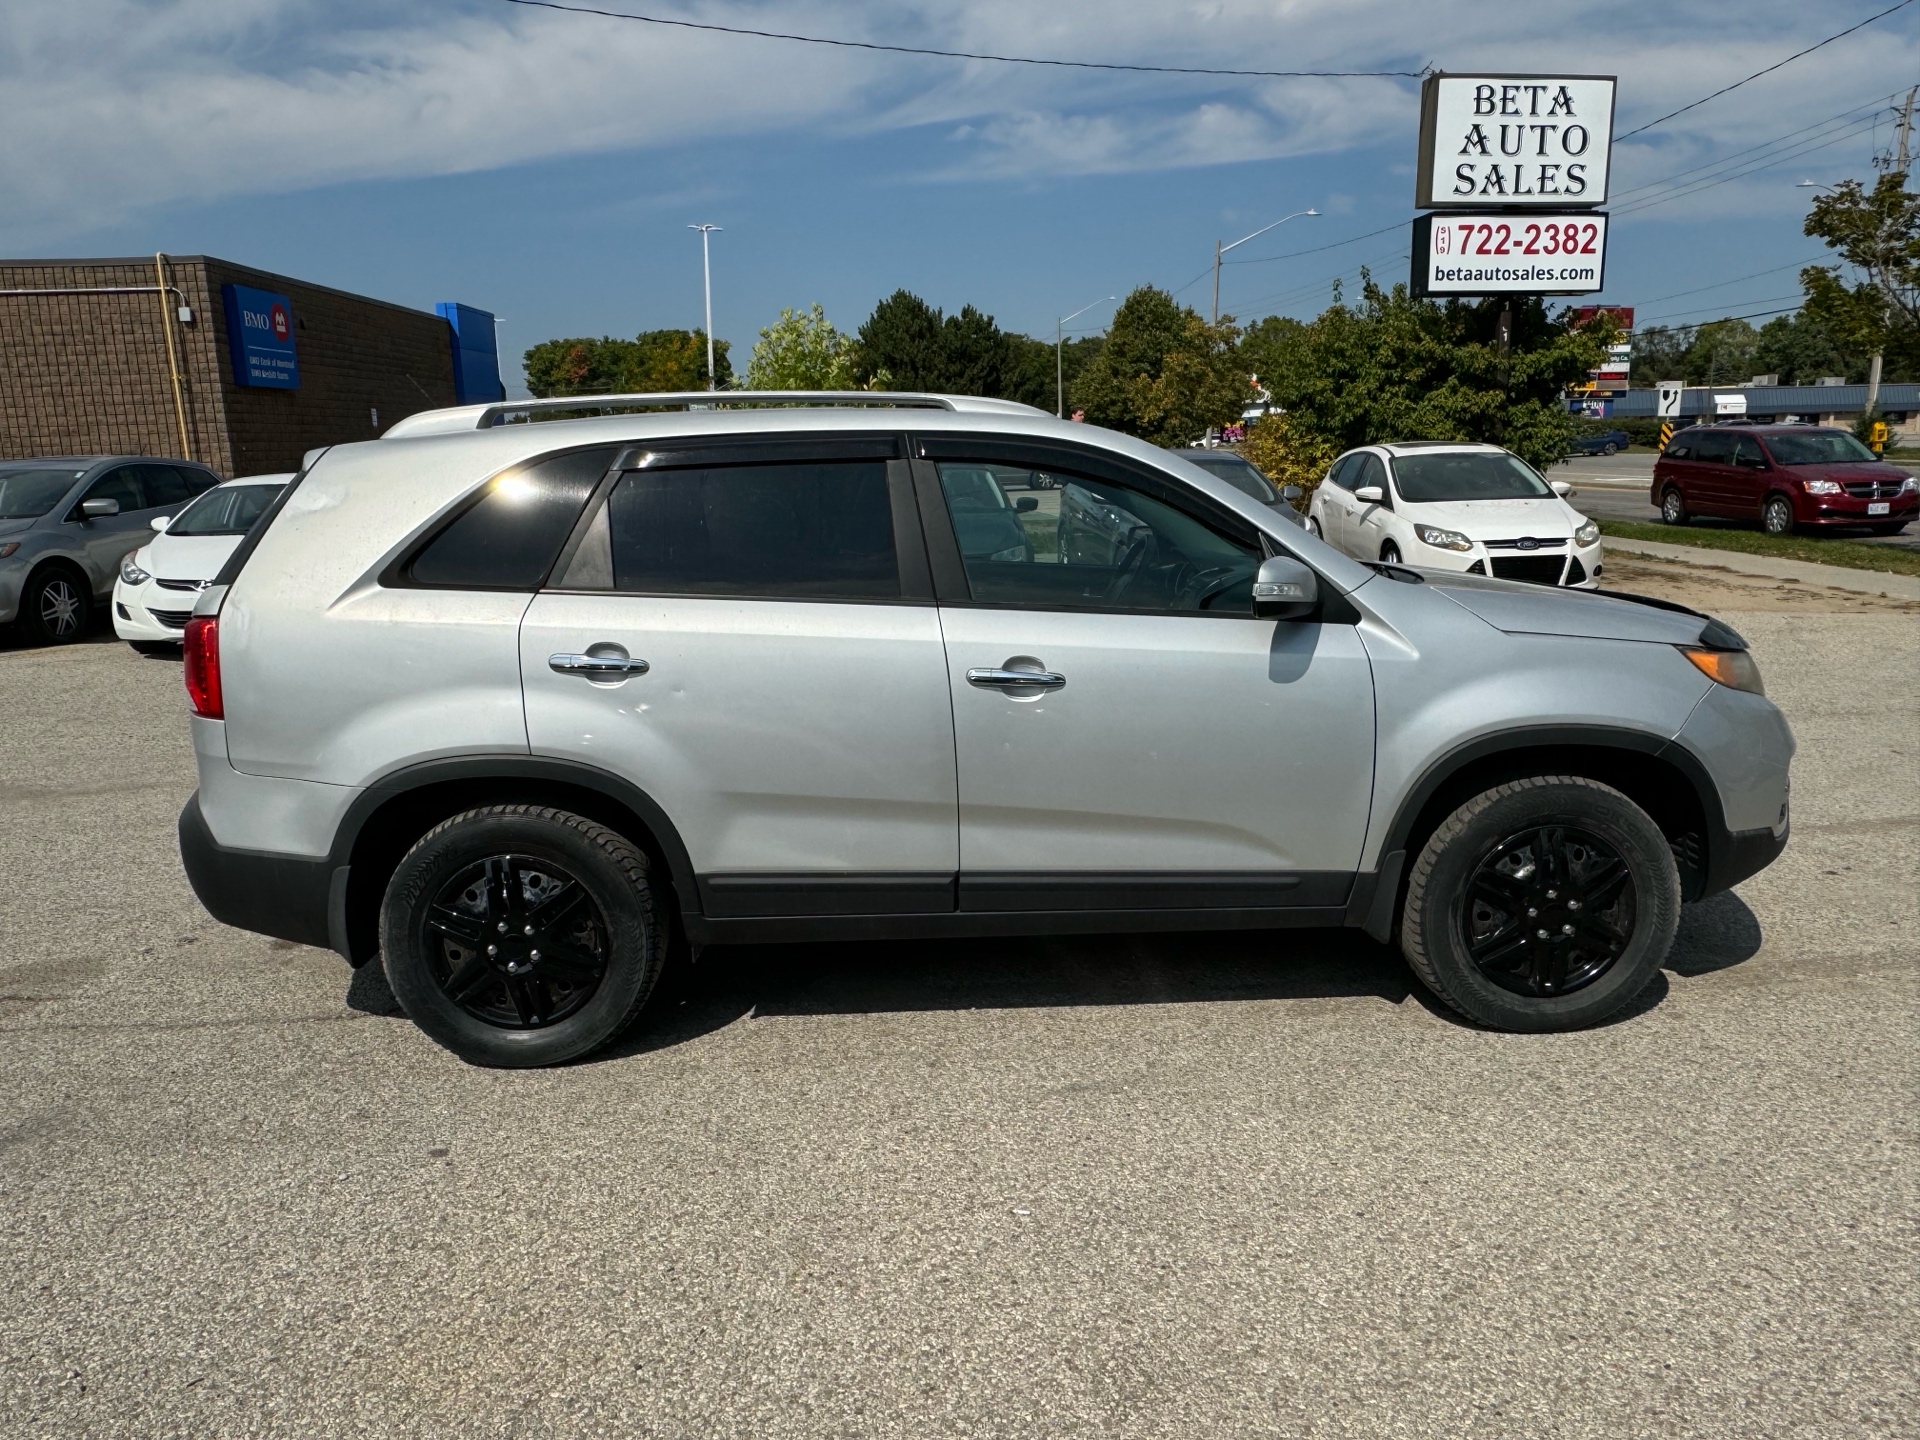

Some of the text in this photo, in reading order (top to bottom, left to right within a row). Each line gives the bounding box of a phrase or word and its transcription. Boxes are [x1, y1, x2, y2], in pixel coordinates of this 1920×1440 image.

[1473, 84, 1577, 117] BETA
[1458, 123, 1590, 157] AUTO
[1452, 163, 1587, 196] SALES
[1457, 223, 1598, 255] 722-2382
[1435, 265, 1594, 282] betaautosales.com
[243, 310, 269, 330] BMO
